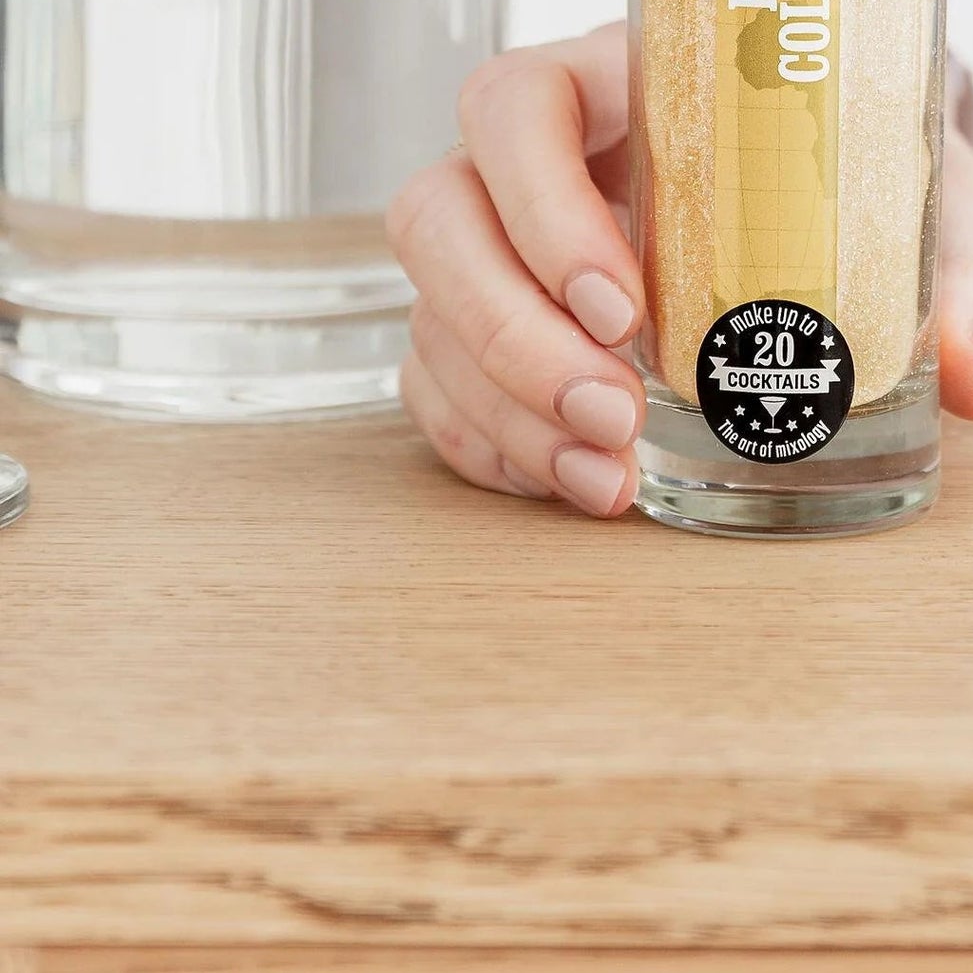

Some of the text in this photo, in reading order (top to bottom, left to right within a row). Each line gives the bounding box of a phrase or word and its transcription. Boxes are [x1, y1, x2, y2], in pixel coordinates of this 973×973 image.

[729, 303, 818, 336] make up to
[753, 331, 795, 367] 20
[727, 371, 820, 390] COCKTAILS
[717, 418, 832, 458] The art of mixology
